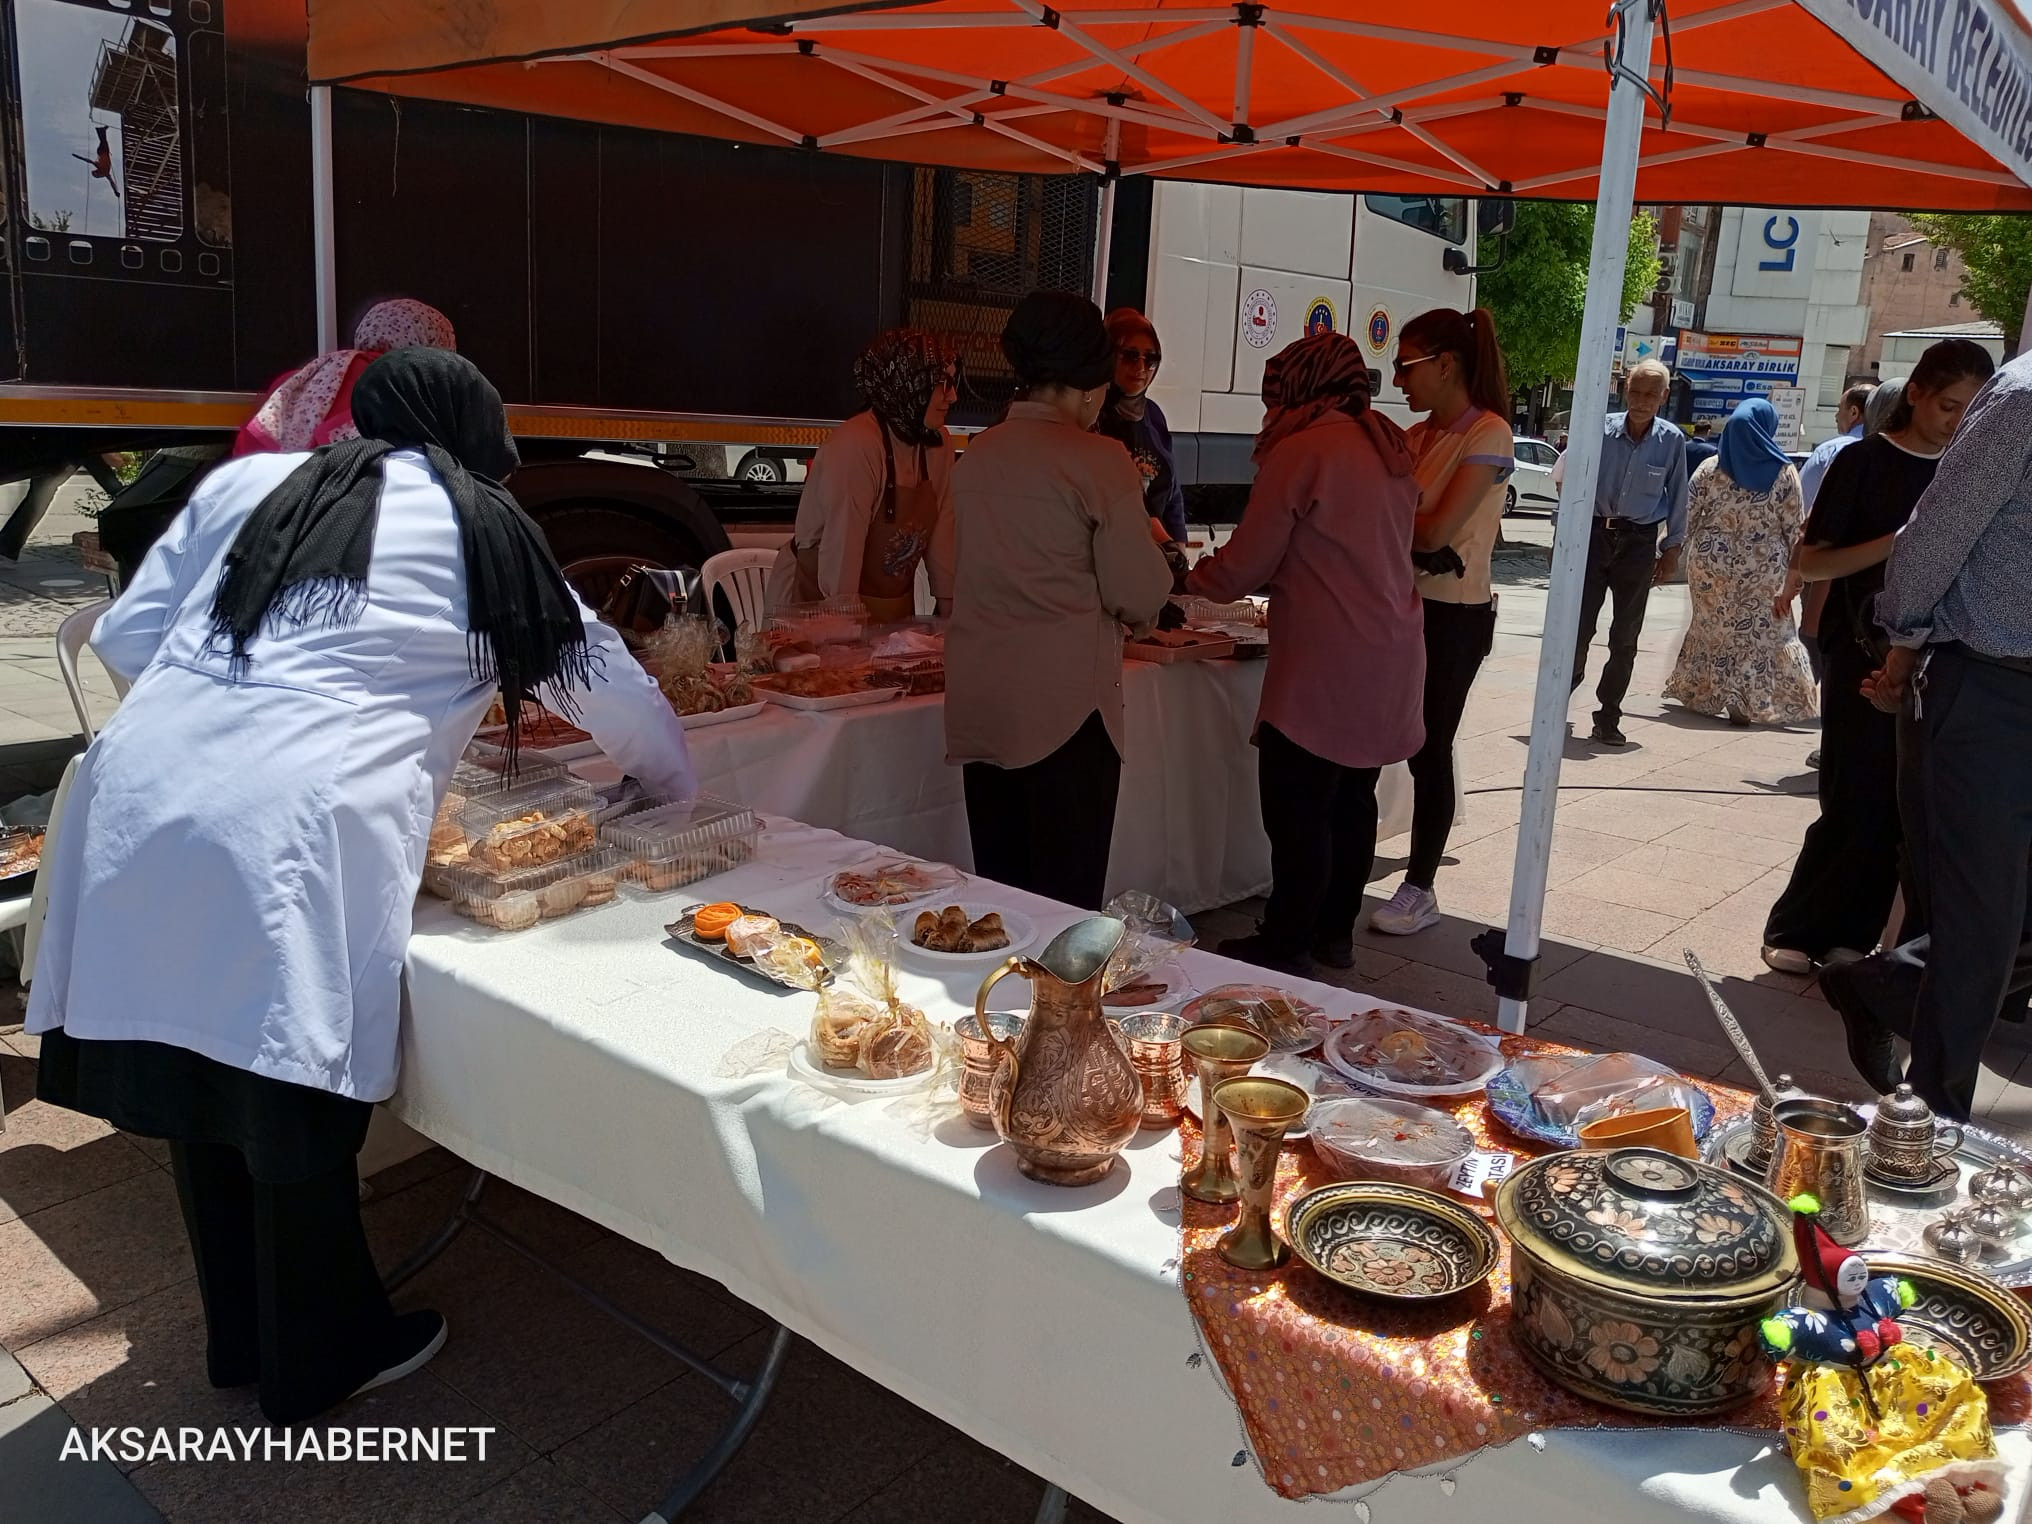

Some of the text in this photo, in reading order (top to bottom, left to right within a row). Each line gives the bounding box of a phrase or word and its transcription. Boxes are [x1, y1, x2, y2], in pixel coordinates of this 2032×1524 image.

[1759, 215, 1799, 272] LC
[1705, 359, 1755, 371] AKSARAY
[1757, 360, 1796, 373] BİRLİK
